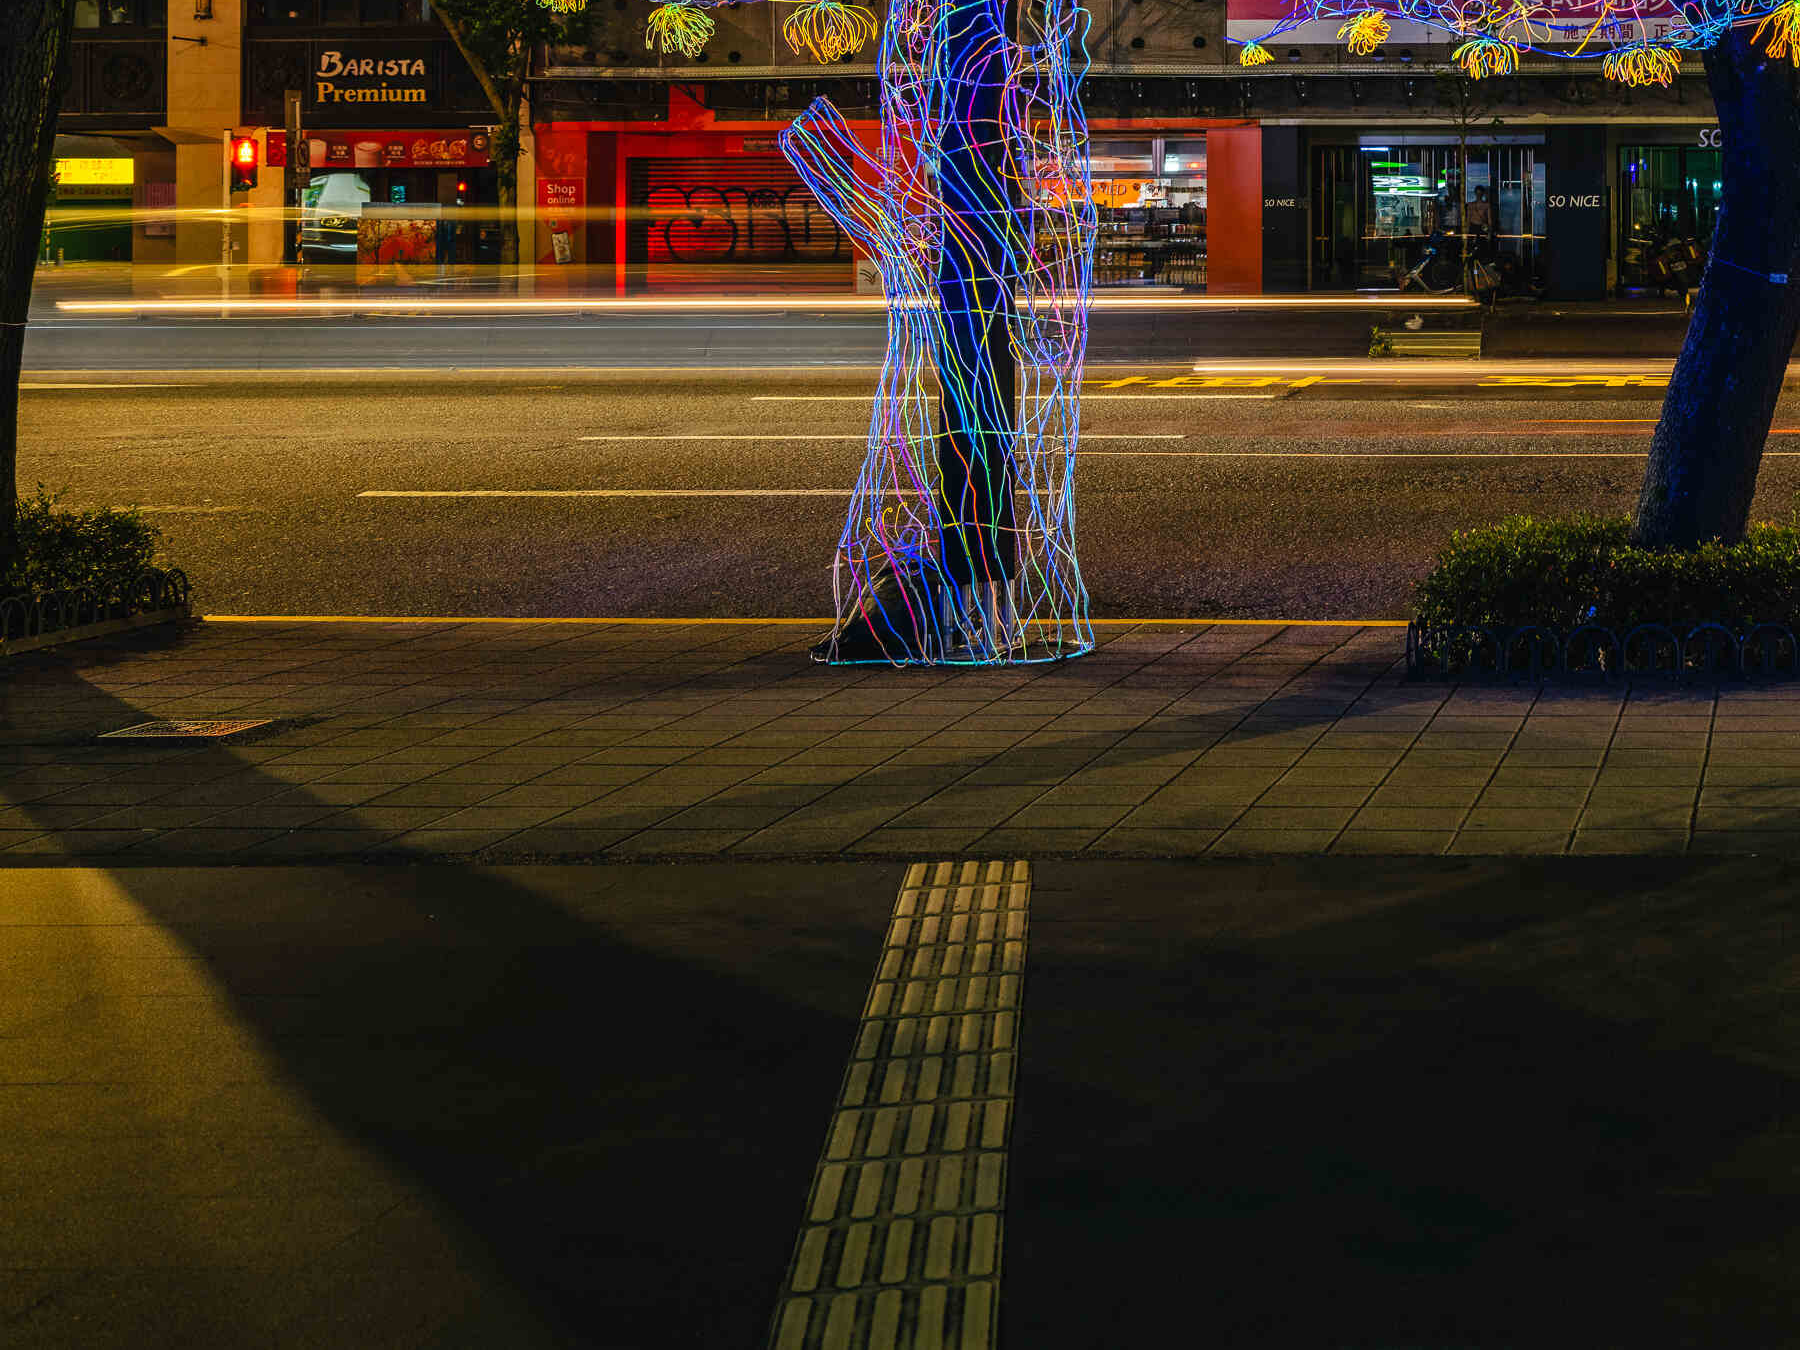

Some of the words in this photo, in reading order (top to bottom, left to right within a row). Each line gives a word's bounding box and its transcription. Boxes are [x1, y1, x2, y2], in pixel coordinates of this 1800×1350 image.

[316, 51, 425, 78] BARISTA
[316, 82, 427, 103] Premium
[546, 184, 576, 197] Shop
[546, 196, 576, 205] online
[1264, 198, 1276, 208] SO
[1277, 198, 1296, 208] NICE
[1547, 195, 1567, 208] SO
[1568, 195, 1600, 208] NICE
